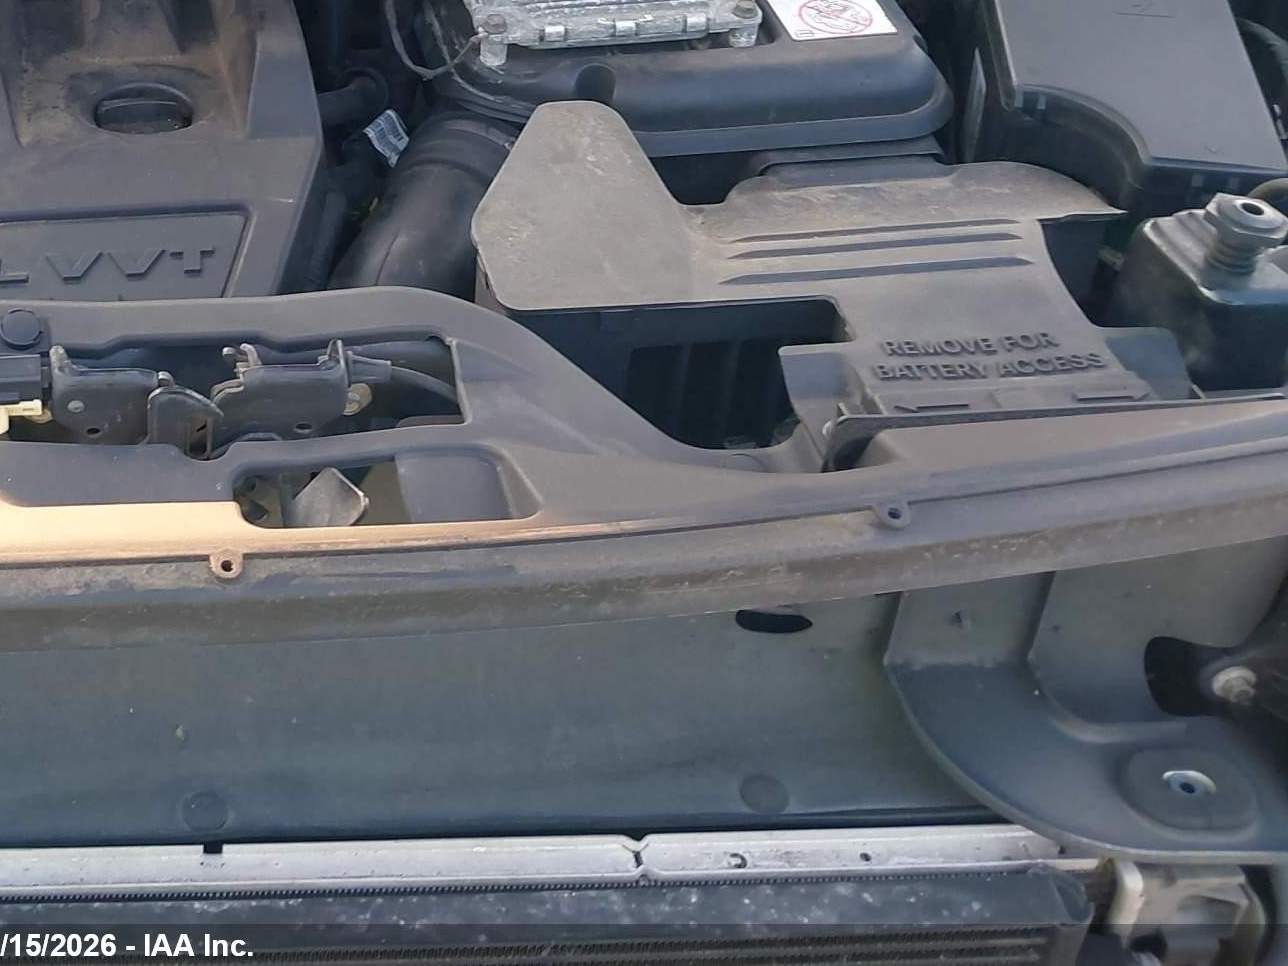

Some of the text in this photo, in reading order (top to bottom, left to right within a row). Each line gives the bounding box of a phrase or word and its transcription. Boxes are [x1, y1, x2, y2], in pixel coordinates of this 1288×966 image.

[45, 246, 216, 283] VVT
[883, 332, 1060, 357] REMOVE FOR
[876, 352, 1107, 381] BATTERY ACCESS
